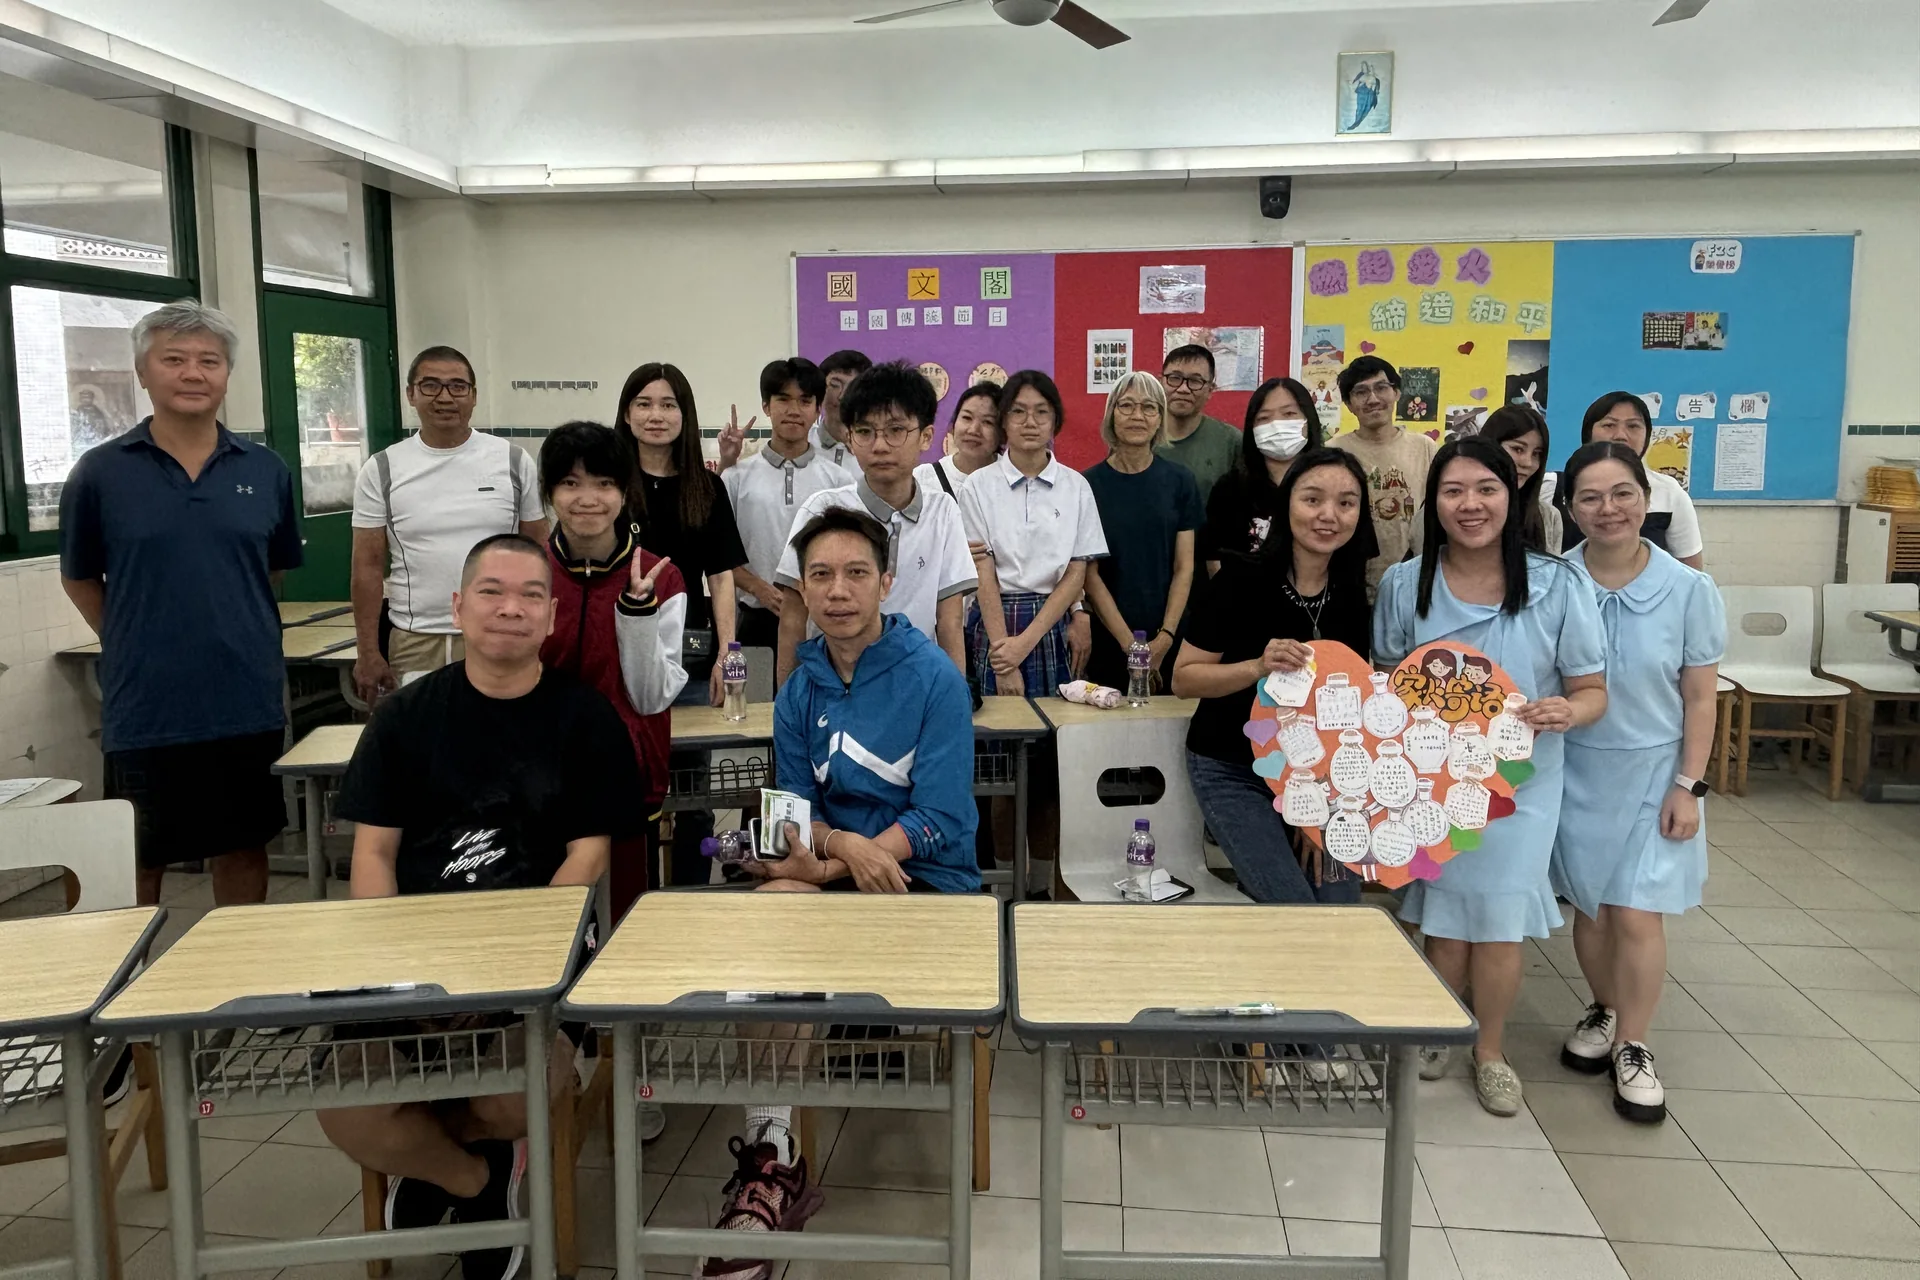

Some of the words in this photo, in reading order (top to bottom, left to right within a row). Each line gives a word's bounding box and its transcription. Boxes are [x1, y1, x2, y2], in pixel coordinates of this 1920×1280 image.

[830, 270, 1008, 299] 國文閣
[1371, 291, 1549, 334] 締造和平
[452, 828, 501, 850] LIVE
[441, 847, 507, 879] HOOPS
[201, 1102, 211, 1114] 17
